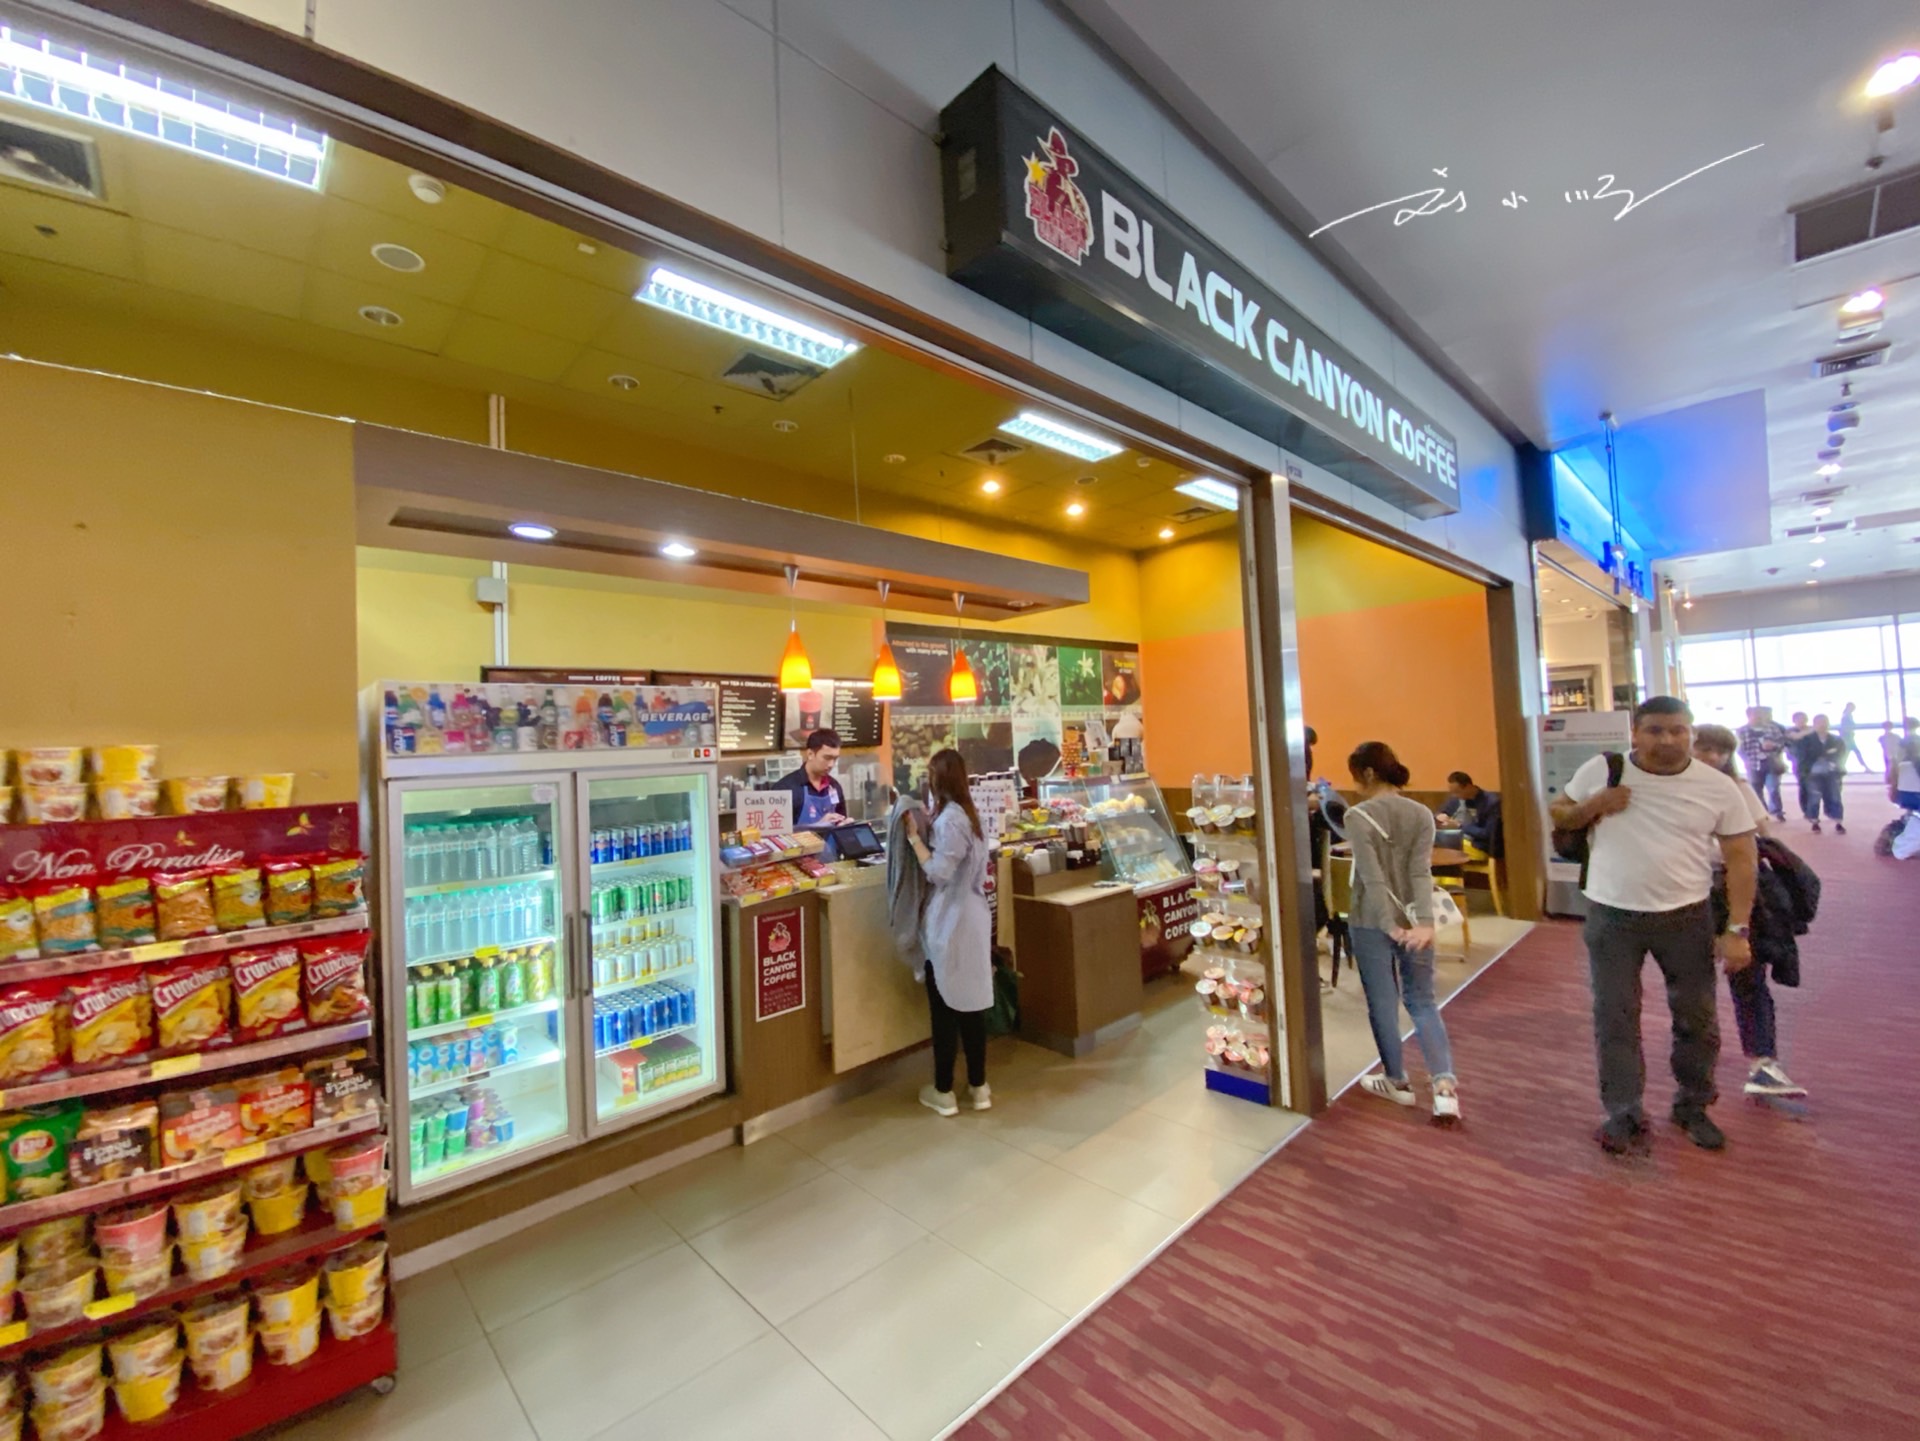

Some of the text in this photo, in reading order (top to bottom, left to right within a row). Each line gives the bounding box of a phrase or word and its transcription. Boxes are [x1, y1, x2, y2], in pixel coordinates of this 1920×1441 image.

[1101, 190, 1262, 361] BLACK
[1266, 318, 1385, 443] CANYON
[1387, 407, 1457, 490] COFFEE
[641, 712, 709, 723] BEVERAGE
[744, 796, 787, 807] Cash Only
[746, 808, 785, 830] 现金
[1162, 889, 1192, 908] BLAC
[1165, 921, 1194, 940] COFF
[763, 950, 796, 967] BLACK
[763, 961, 797, 977] CANYON
[763, 970, 797, 987] COFFEE
